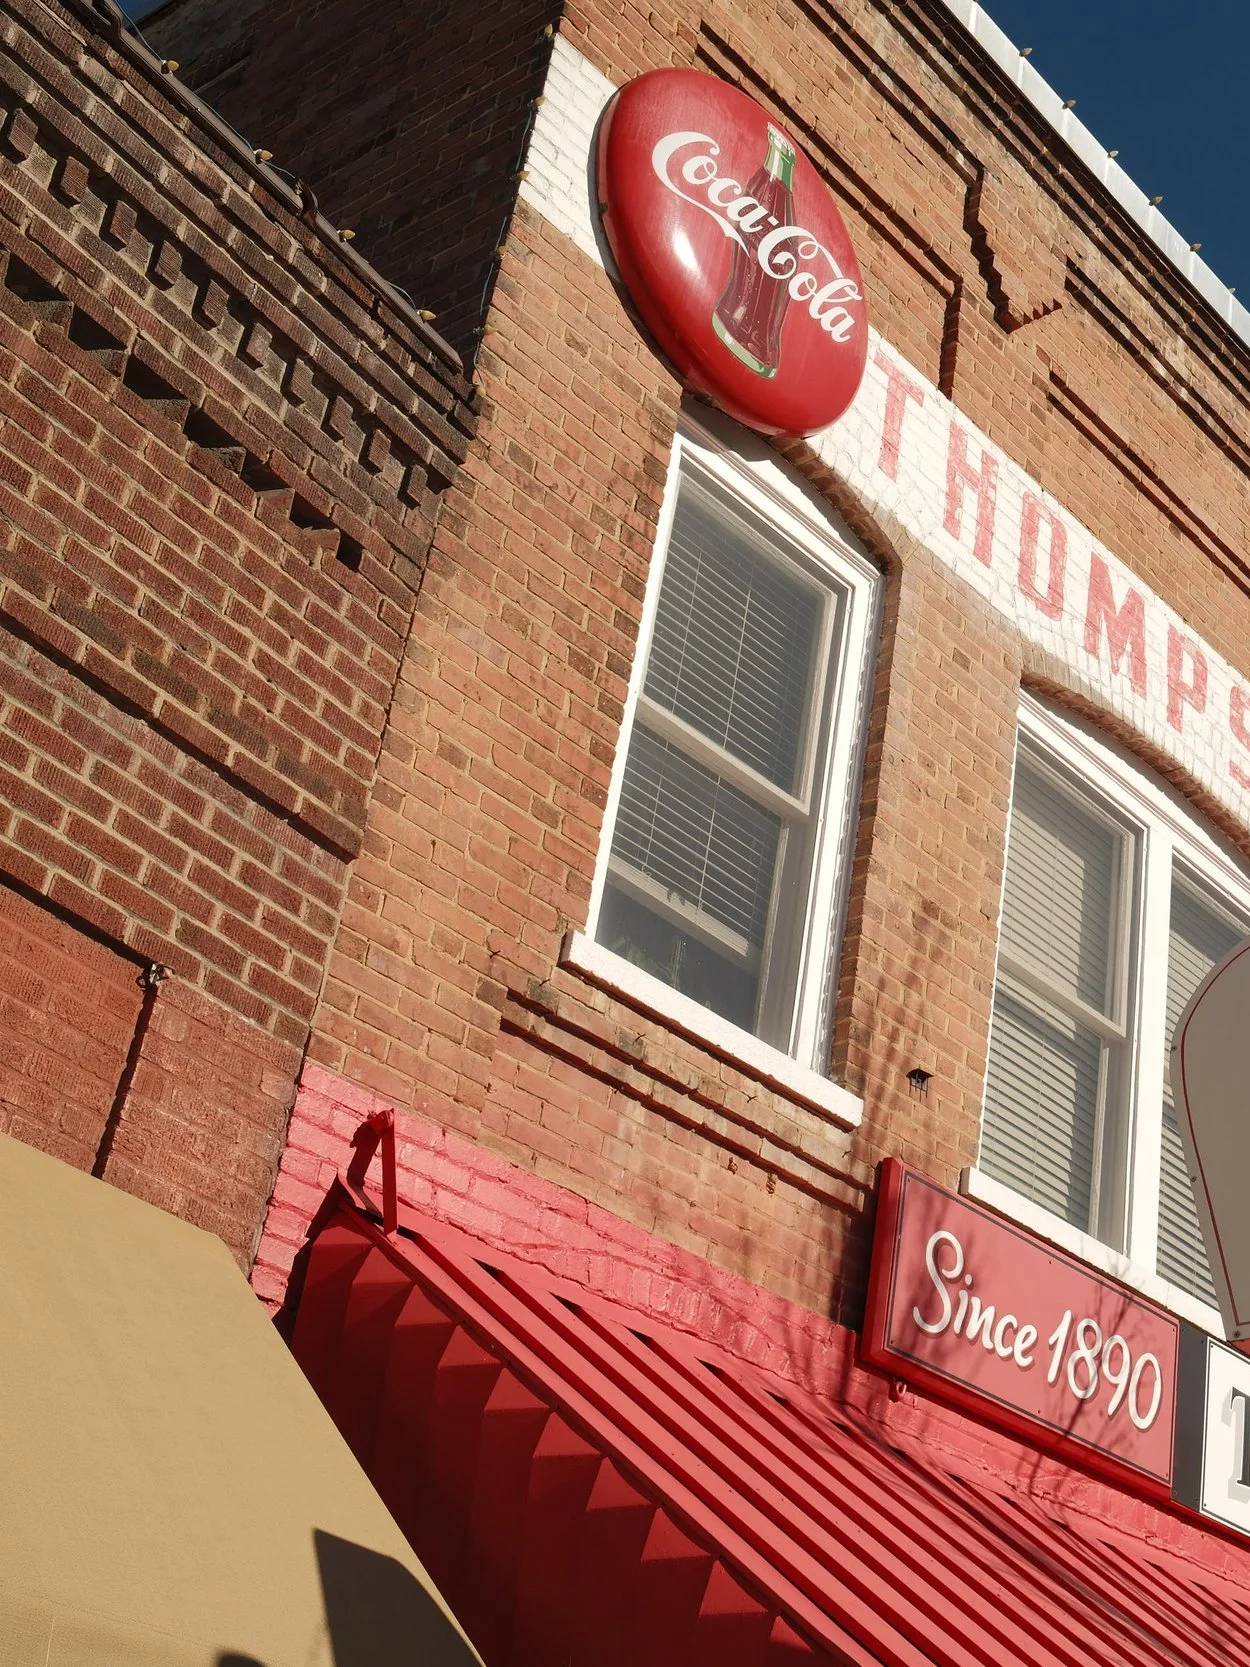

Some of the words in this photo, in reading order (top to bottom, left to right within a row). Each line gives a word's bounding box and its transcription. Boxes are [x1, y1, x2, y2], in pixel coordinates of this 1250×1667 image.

[651, 131, 863, 343] Coca-Cola
[912, 1230, 1038, 1367] Since
[1047, 1309, 1162, 1430] 1890
